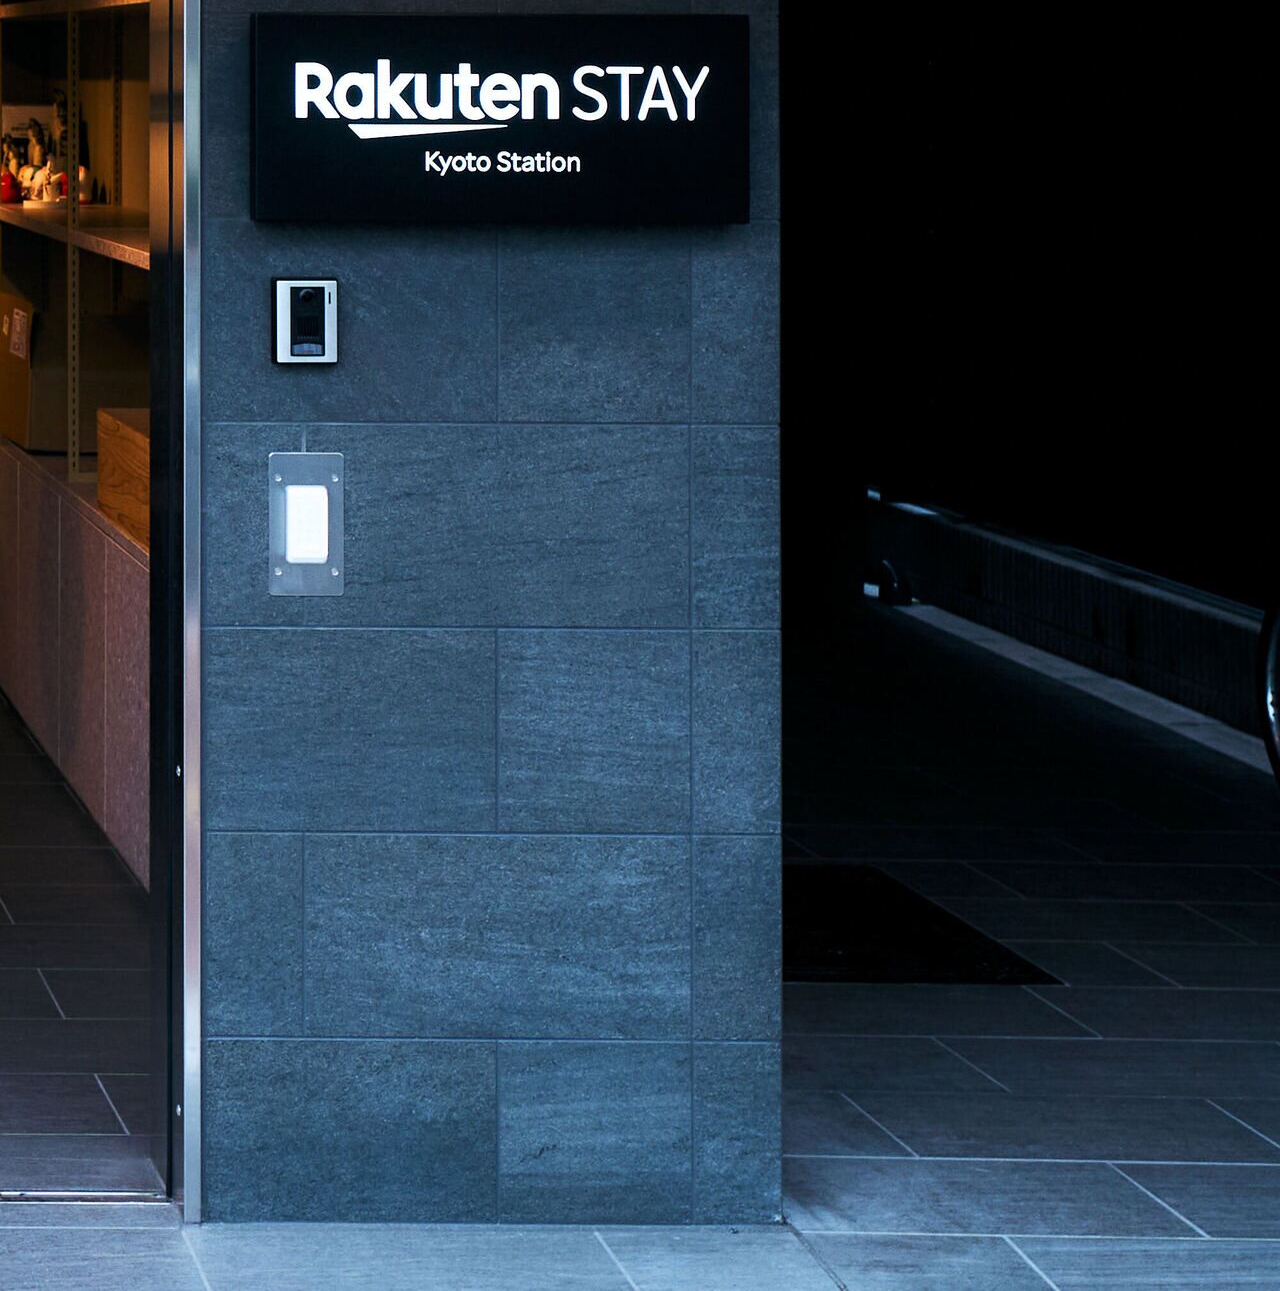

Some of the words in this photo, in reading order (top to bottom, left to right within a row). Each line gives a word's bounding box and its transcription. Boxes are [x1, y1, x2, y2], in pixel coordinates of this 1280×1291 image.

[294, 59, 560, 121] Rakuten
[571, 64, 710, 122] STAY
[424, 150, 492, 177] Kyoto
[496, 150, 581, 173] Station
